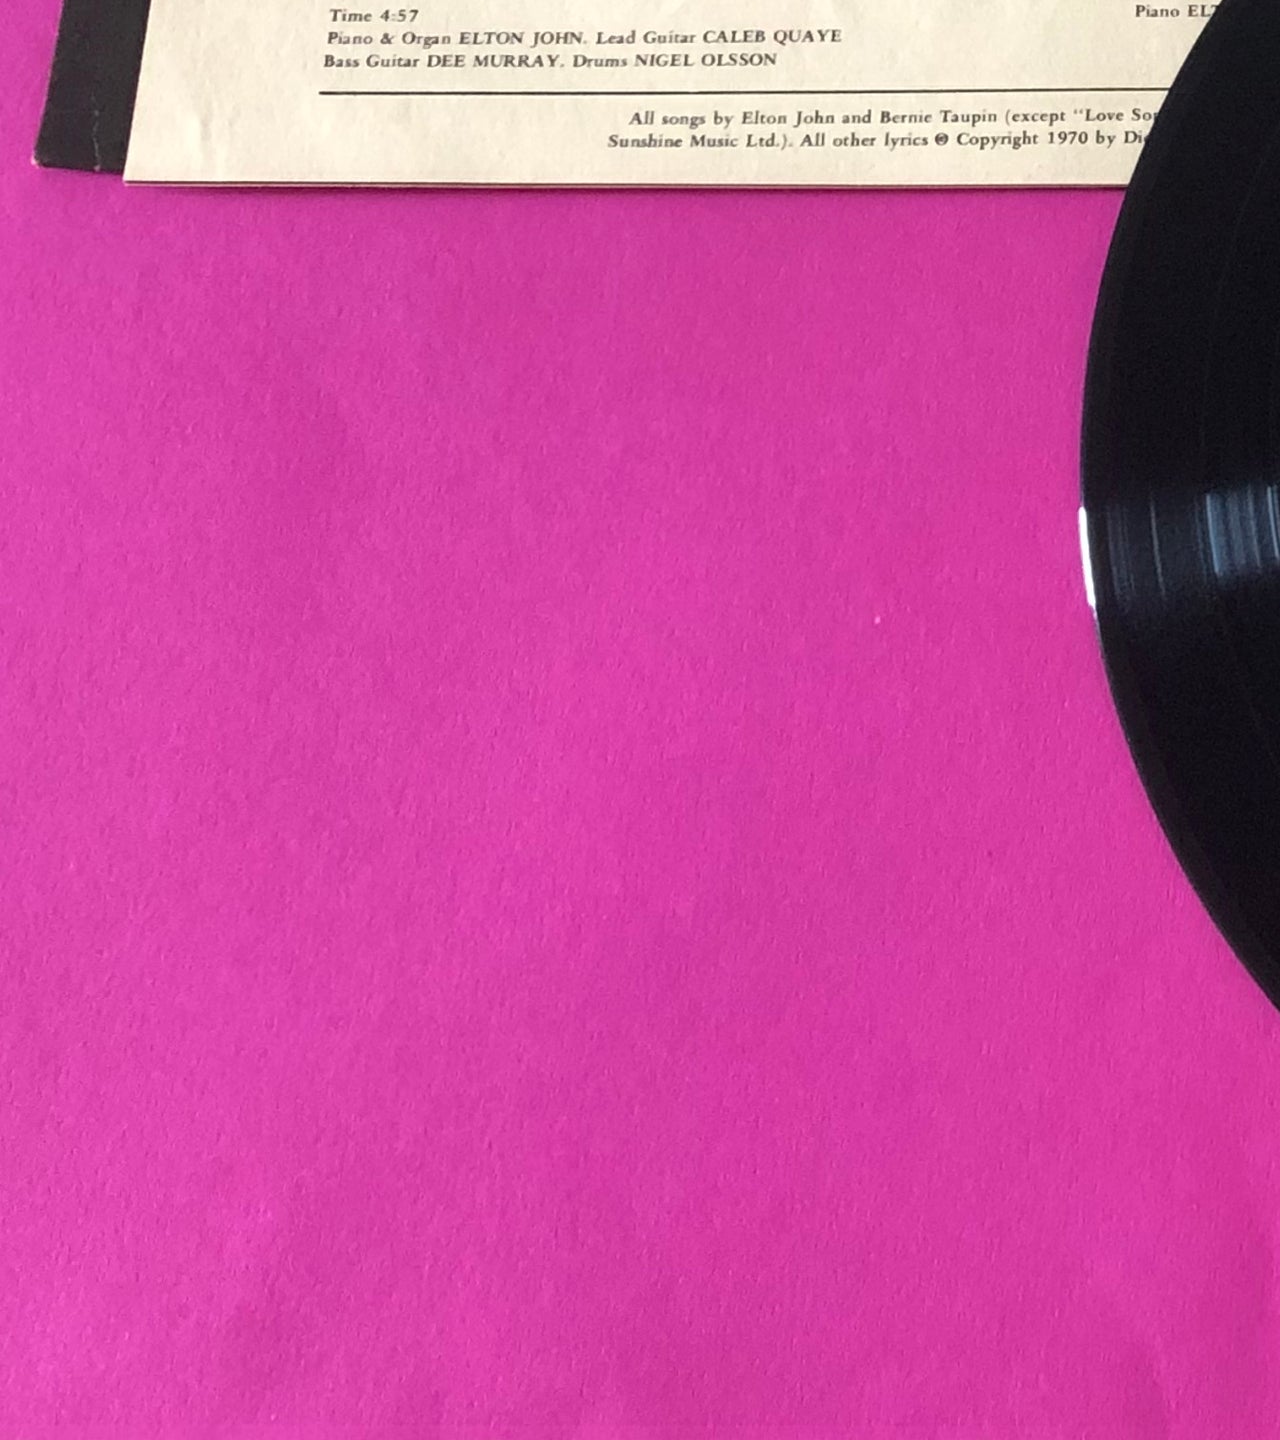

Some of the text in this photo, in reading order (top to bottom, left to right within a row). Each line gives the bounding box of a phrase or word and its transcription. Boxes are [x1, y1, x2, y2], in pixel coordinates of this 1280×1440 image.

[323, 52, 778, 69] Bass Guitar DEE MURRAY. Drums NIGEL OLSSON
[628, 110, 655, 126] All
[661, 115, 707, 131] songs
[713, 109, 734, 130] by
[741, 109, 788, 125] Elton
[792, 109, 835, 129] John
[841, 108, 872, 125] and
[879, 110, 933, 125] Bernie
[939, 108, 998, 128] Taupin
[1004, 108, 1066, 128] (except
